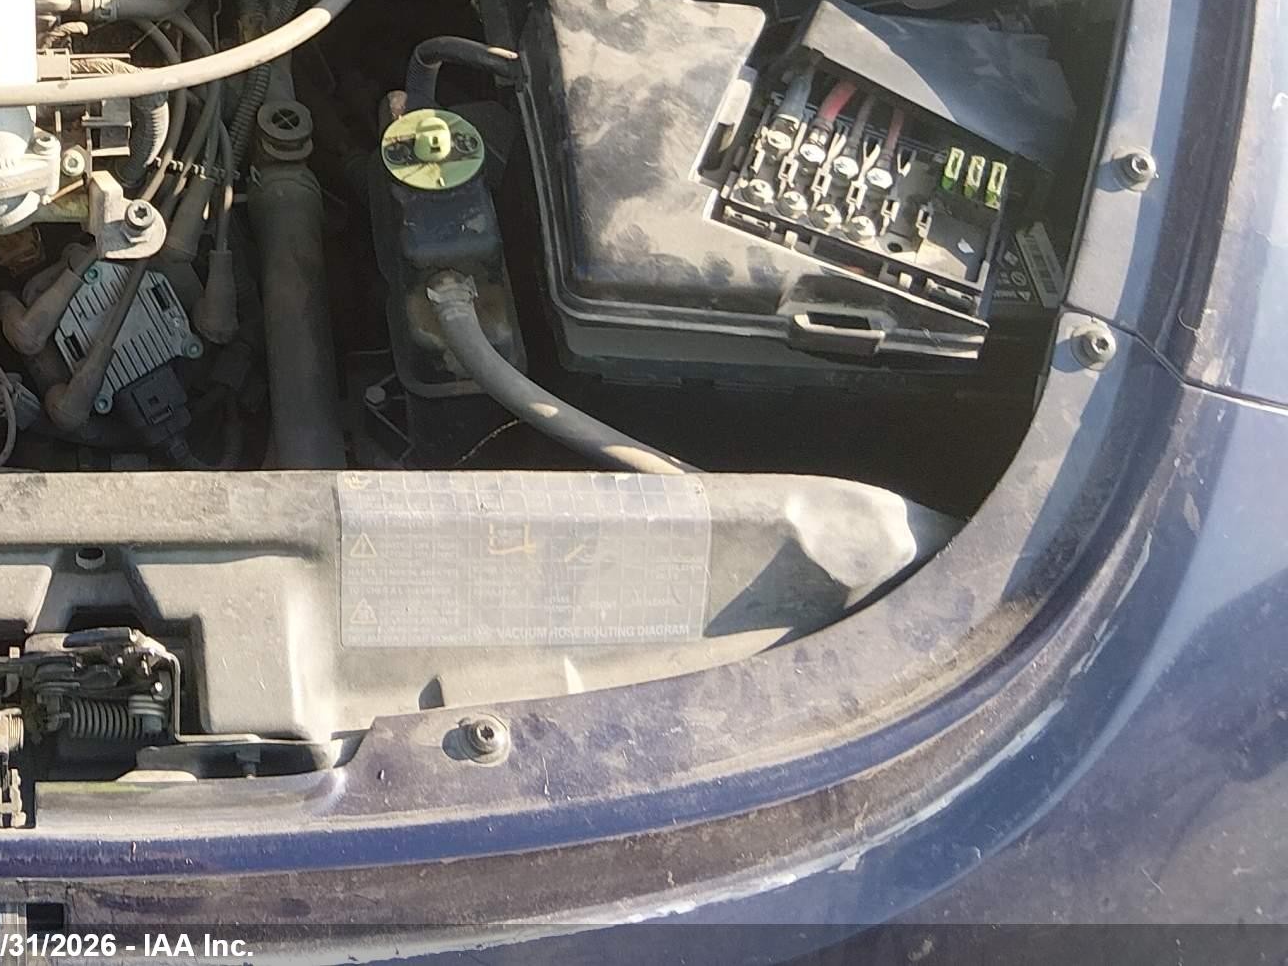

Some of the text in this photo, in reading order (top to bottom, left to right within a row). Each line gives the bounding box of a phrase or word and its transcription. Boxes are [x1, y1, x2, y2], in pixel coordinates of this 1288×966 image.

[496, 627, 548, 640] VACUUM
[583, 625, 634, 639] ROUTING
[636, 624, 689, 637] DIAGRAM
